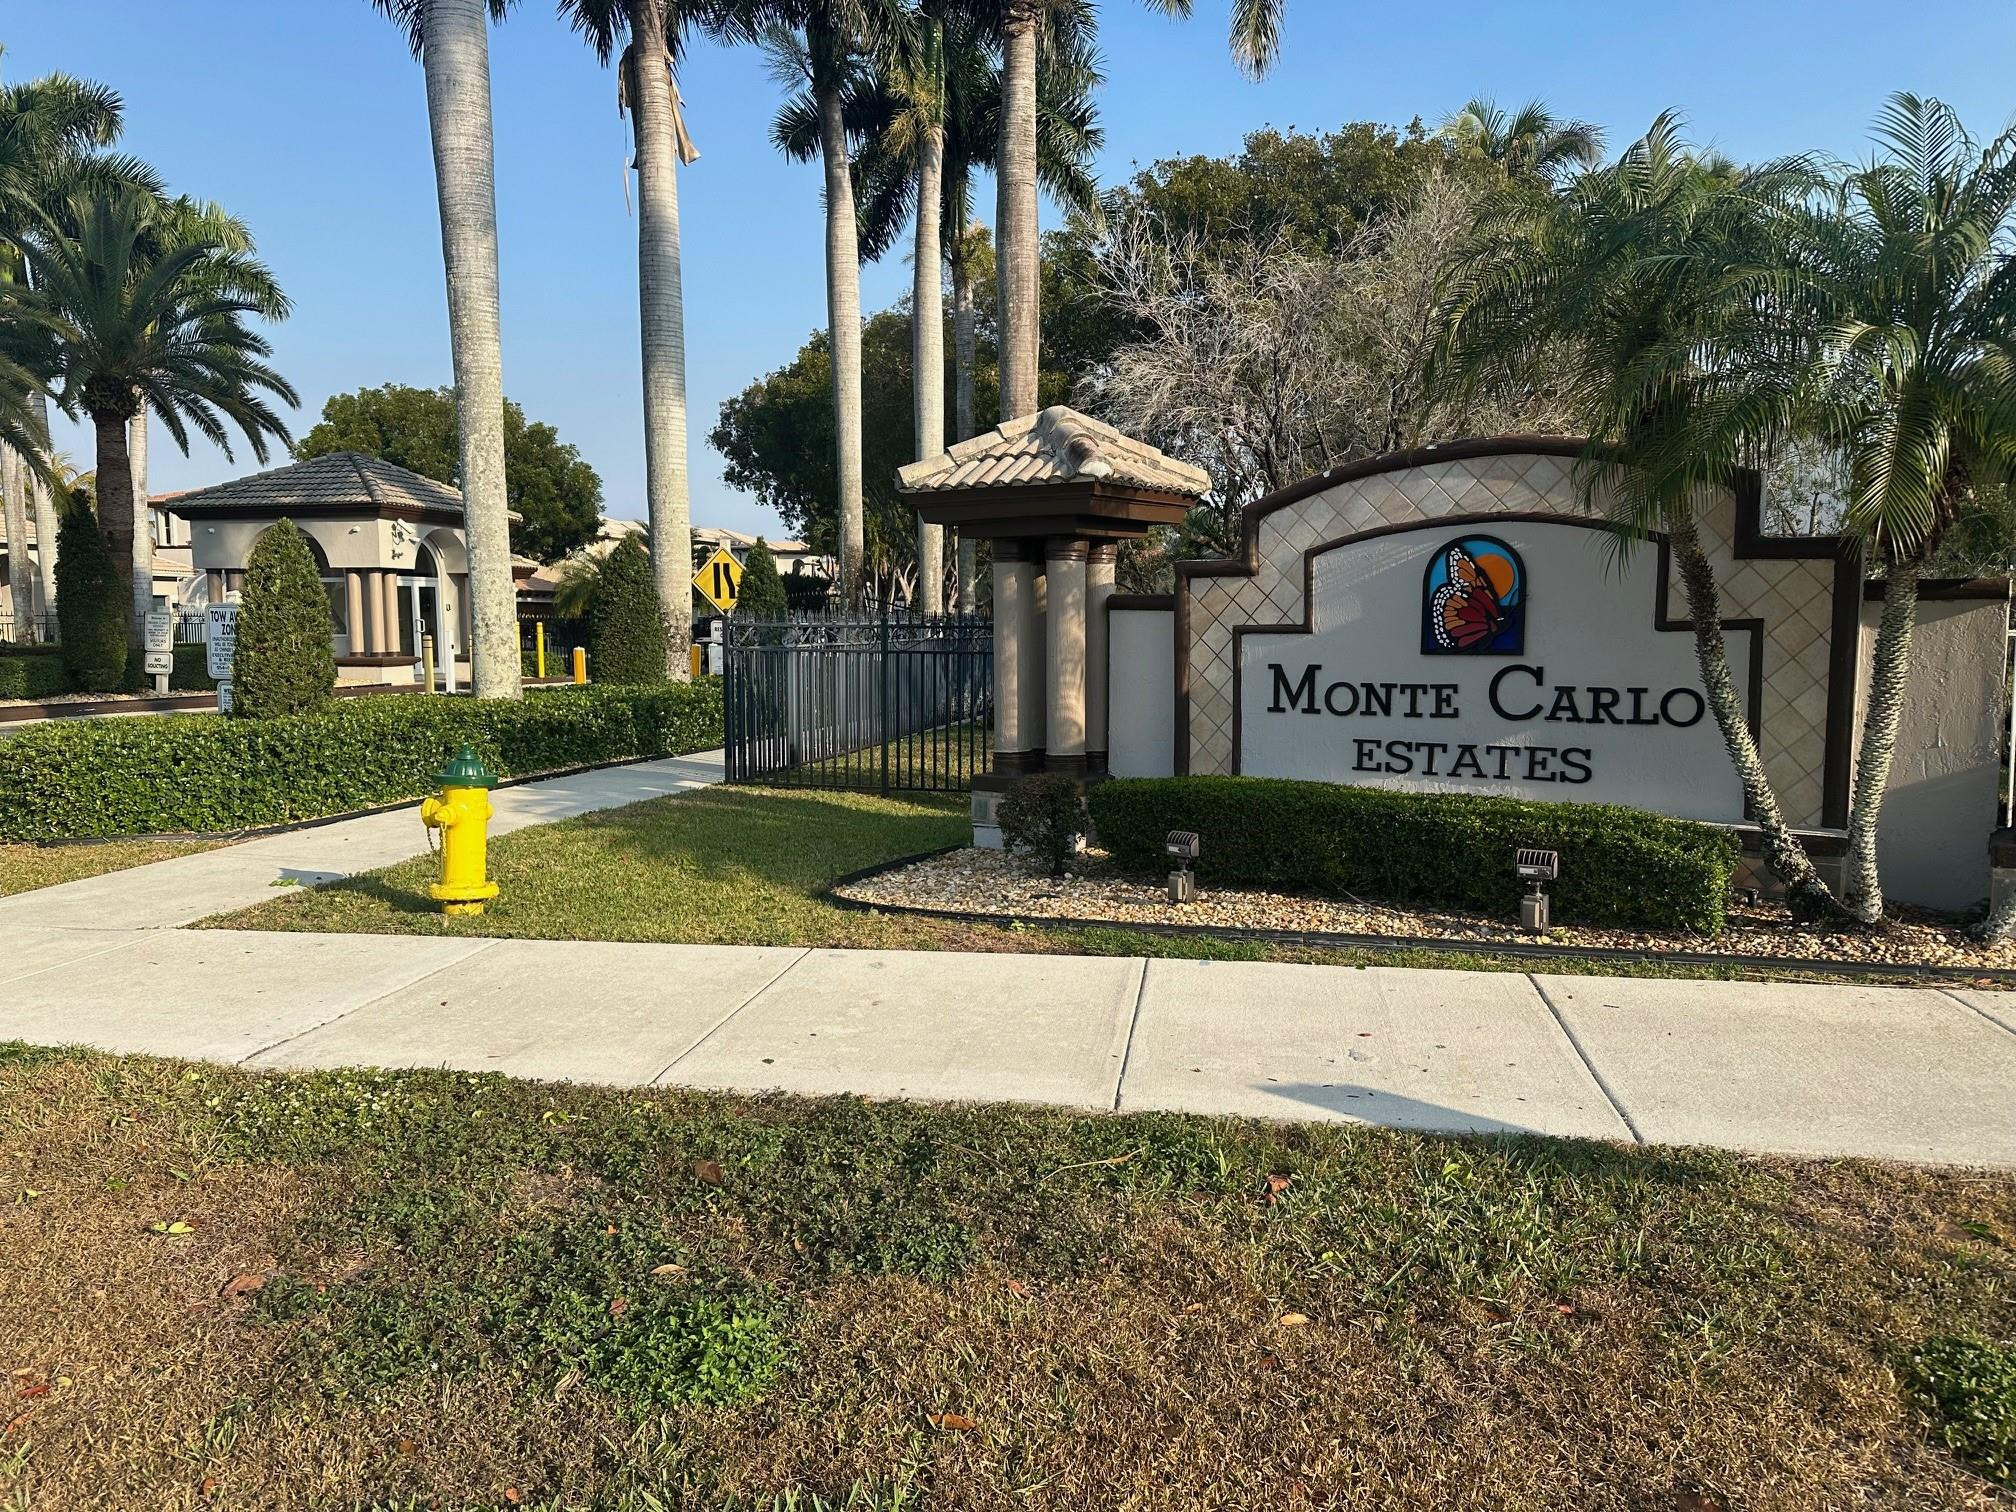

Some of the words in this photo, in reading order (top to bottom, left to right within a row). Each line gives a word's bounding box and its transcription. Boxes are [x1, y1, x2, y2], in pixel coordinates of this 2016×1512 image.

[210, 610, 226, 622] TOW
[221, 623, 237, 636] ZON
[1267, 663, 1460, 719] MONTE
[1488, 664, 1706, 728] CARLO
[1351, 738, 1594, 784] ESTATES
